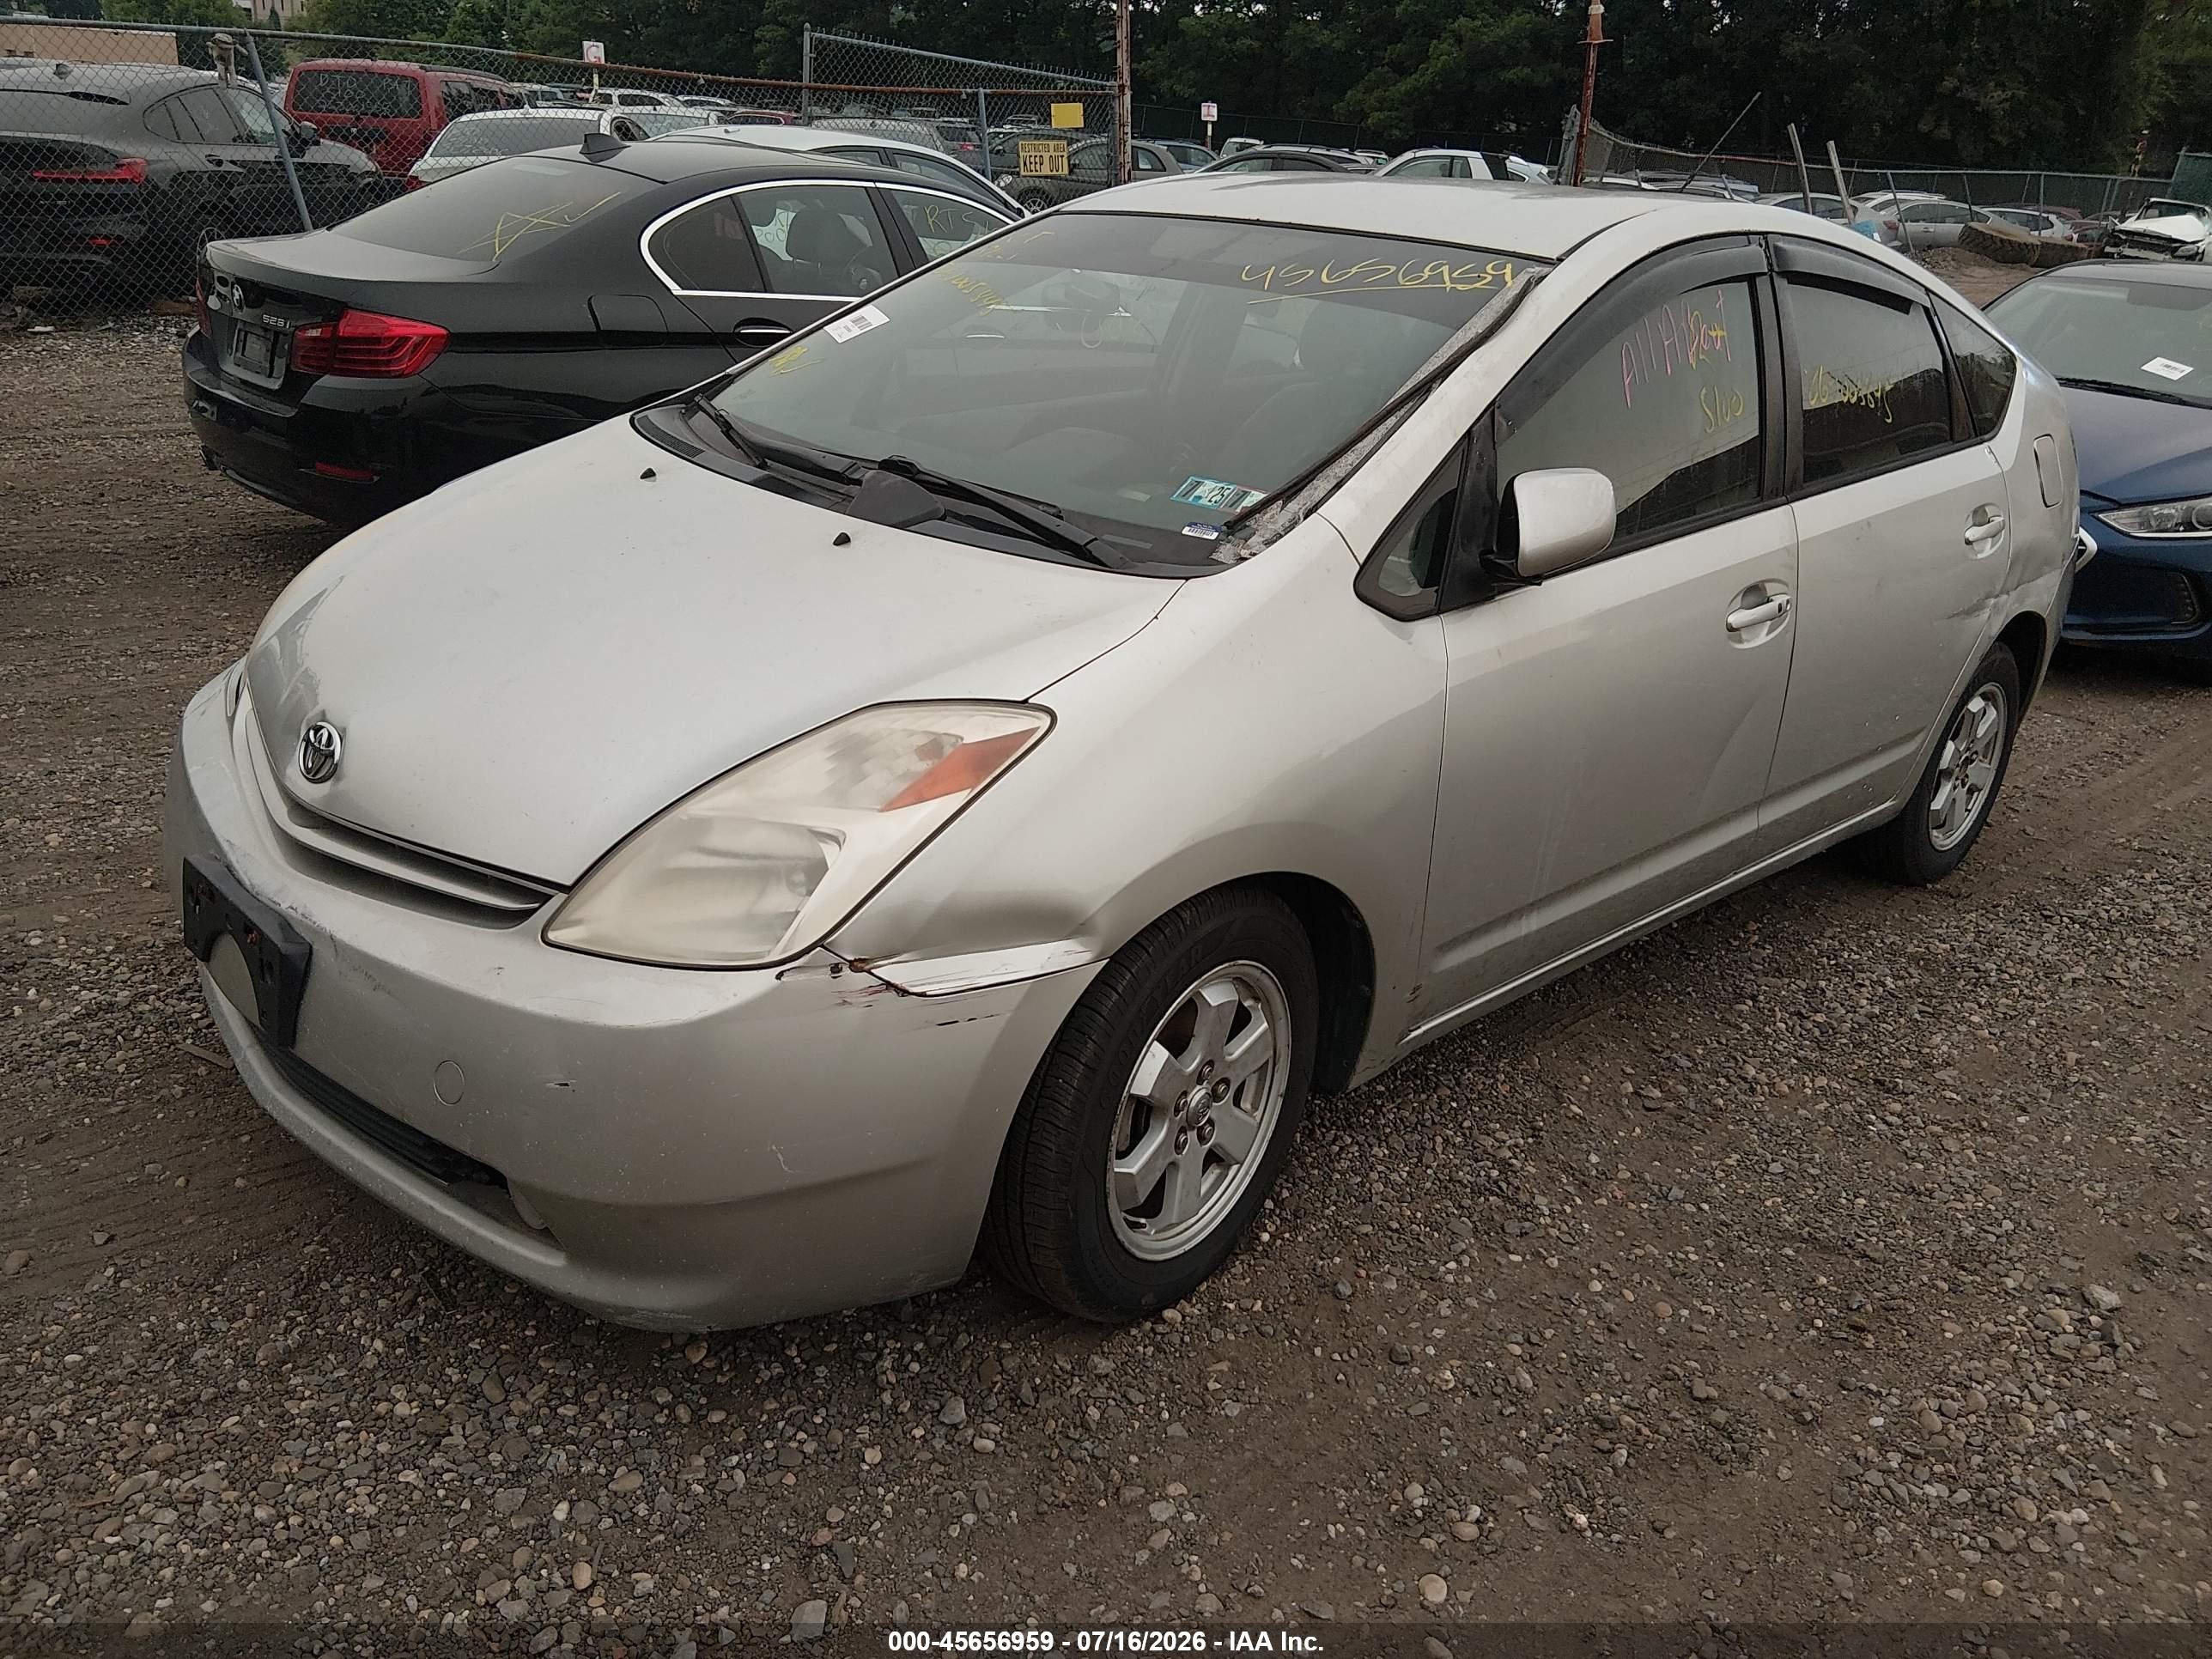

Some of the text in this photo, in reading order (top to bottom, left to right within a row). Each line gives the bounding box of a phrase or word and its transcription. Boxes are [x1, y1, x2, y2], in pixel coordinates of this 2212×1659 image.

[1020, 143, 1066, 153] RESTRICTED AREA
[1022, 155, 1065, 173] KEEP OUT
[1240, 258, 1513, 293] 45656959
[1206, 486, 1231, 504] 25
